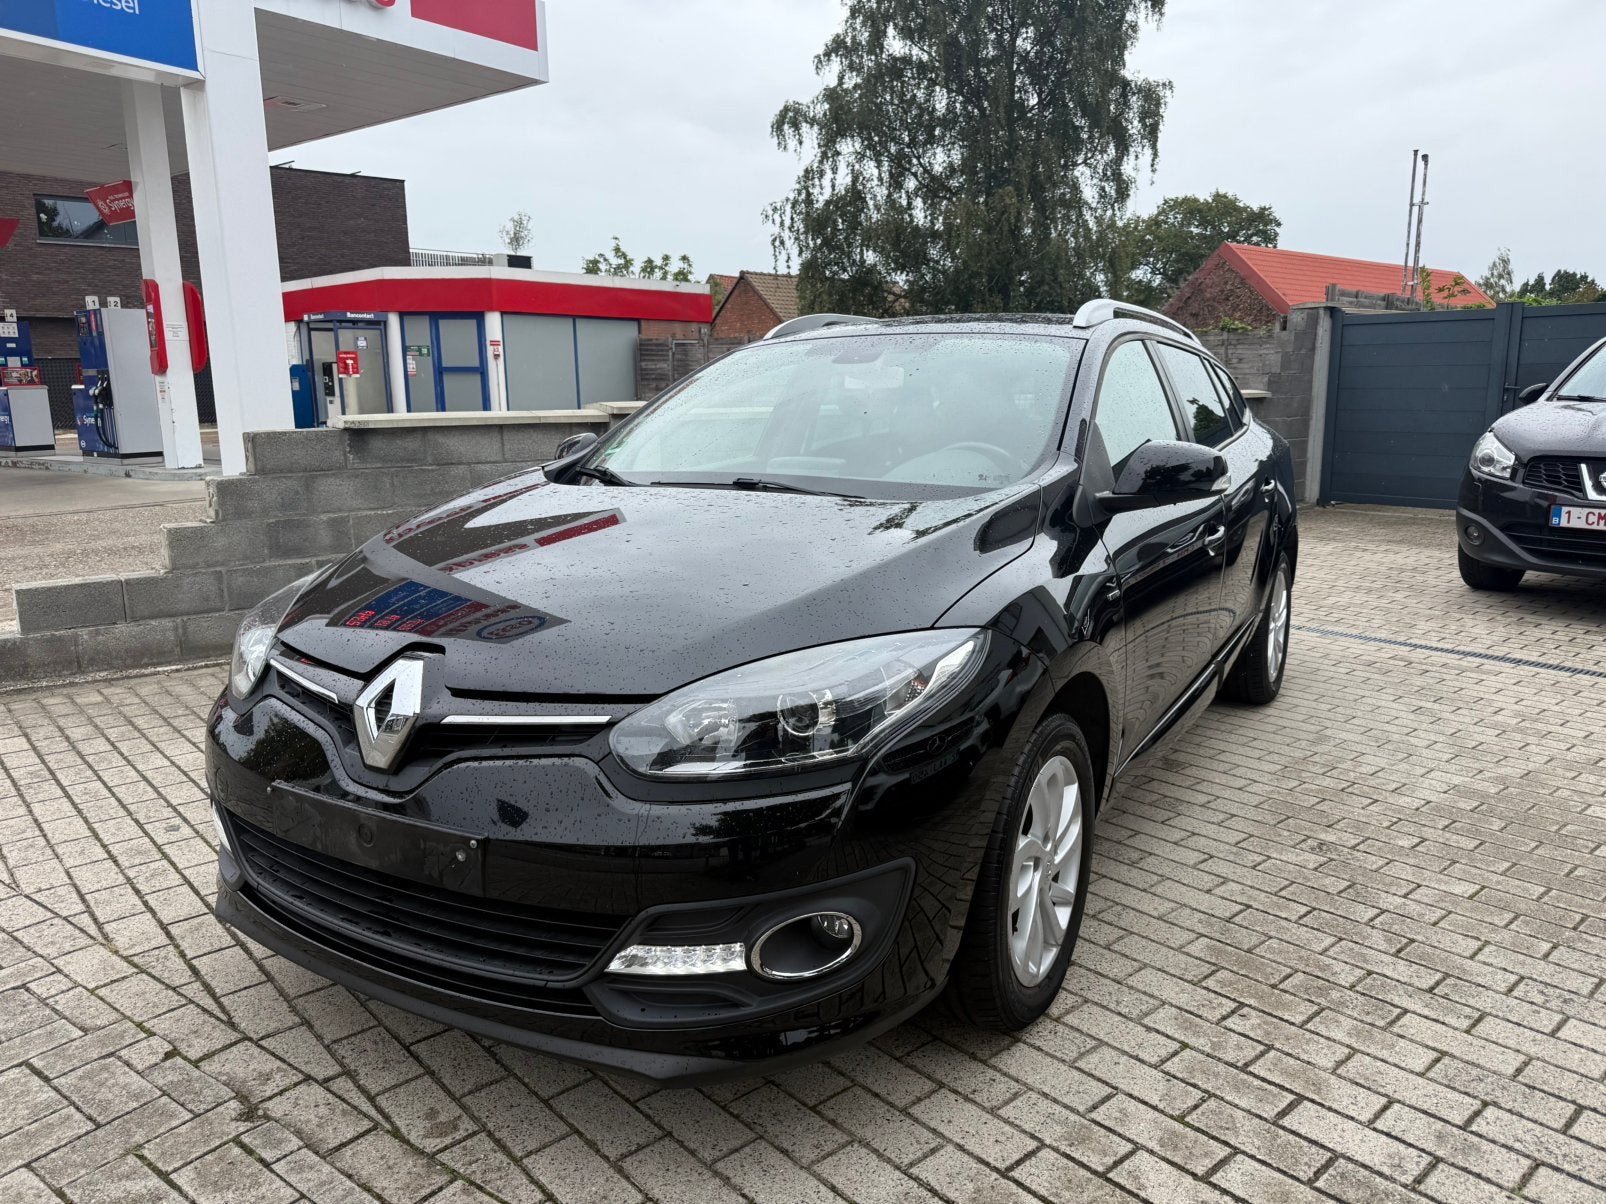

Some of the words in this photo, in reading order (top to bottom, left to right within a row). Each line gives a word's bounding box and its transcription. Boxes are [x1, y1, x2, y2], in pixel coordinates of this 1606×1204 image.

[106, 197, 135, 213] Synergy
[113, 300, 119, 308] 2
[346, 311, 374, 319] Bancontact
[1552, 517, 1559, 525] B
